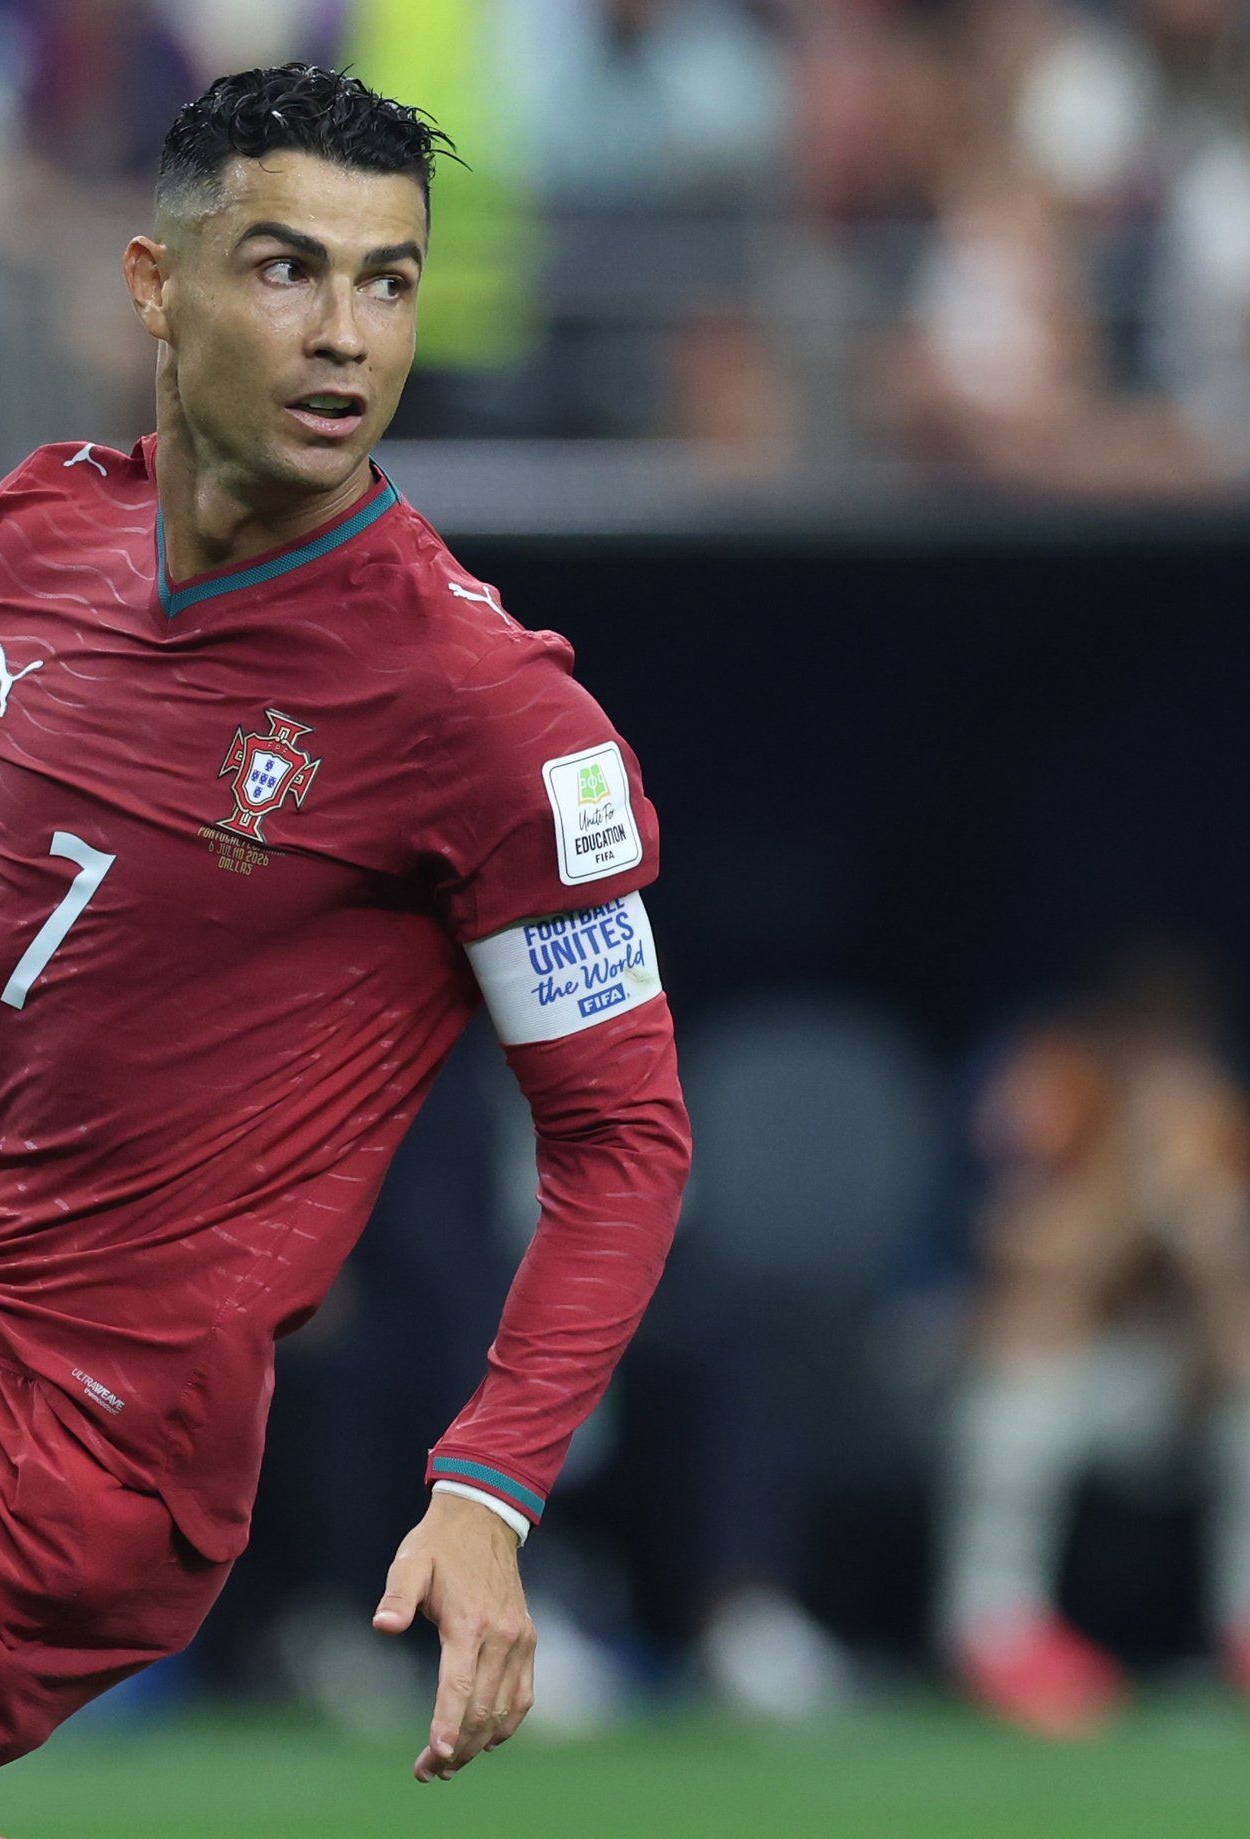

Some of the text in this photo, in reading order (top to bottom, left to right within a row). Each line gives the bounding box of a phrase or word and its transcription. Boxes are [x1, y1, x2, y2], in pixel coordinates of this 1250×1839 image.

[578, 807, 603, 832] Unite
[575, 823, 627, 855] EDUCATION
[218, 856, 253, 876] DALLAS
[245, 850, 269, 867] 2026
[595, 850, 615, 863] FIFA
[0, 831, 117, 1010] 7
[528, 911, 634, 976] UNITES
[531, 939, 645, 1006] the World
[582, 986, 623, 1014] FIFA
[71, 1367, 126, 1411] ULTRAWEAVE
